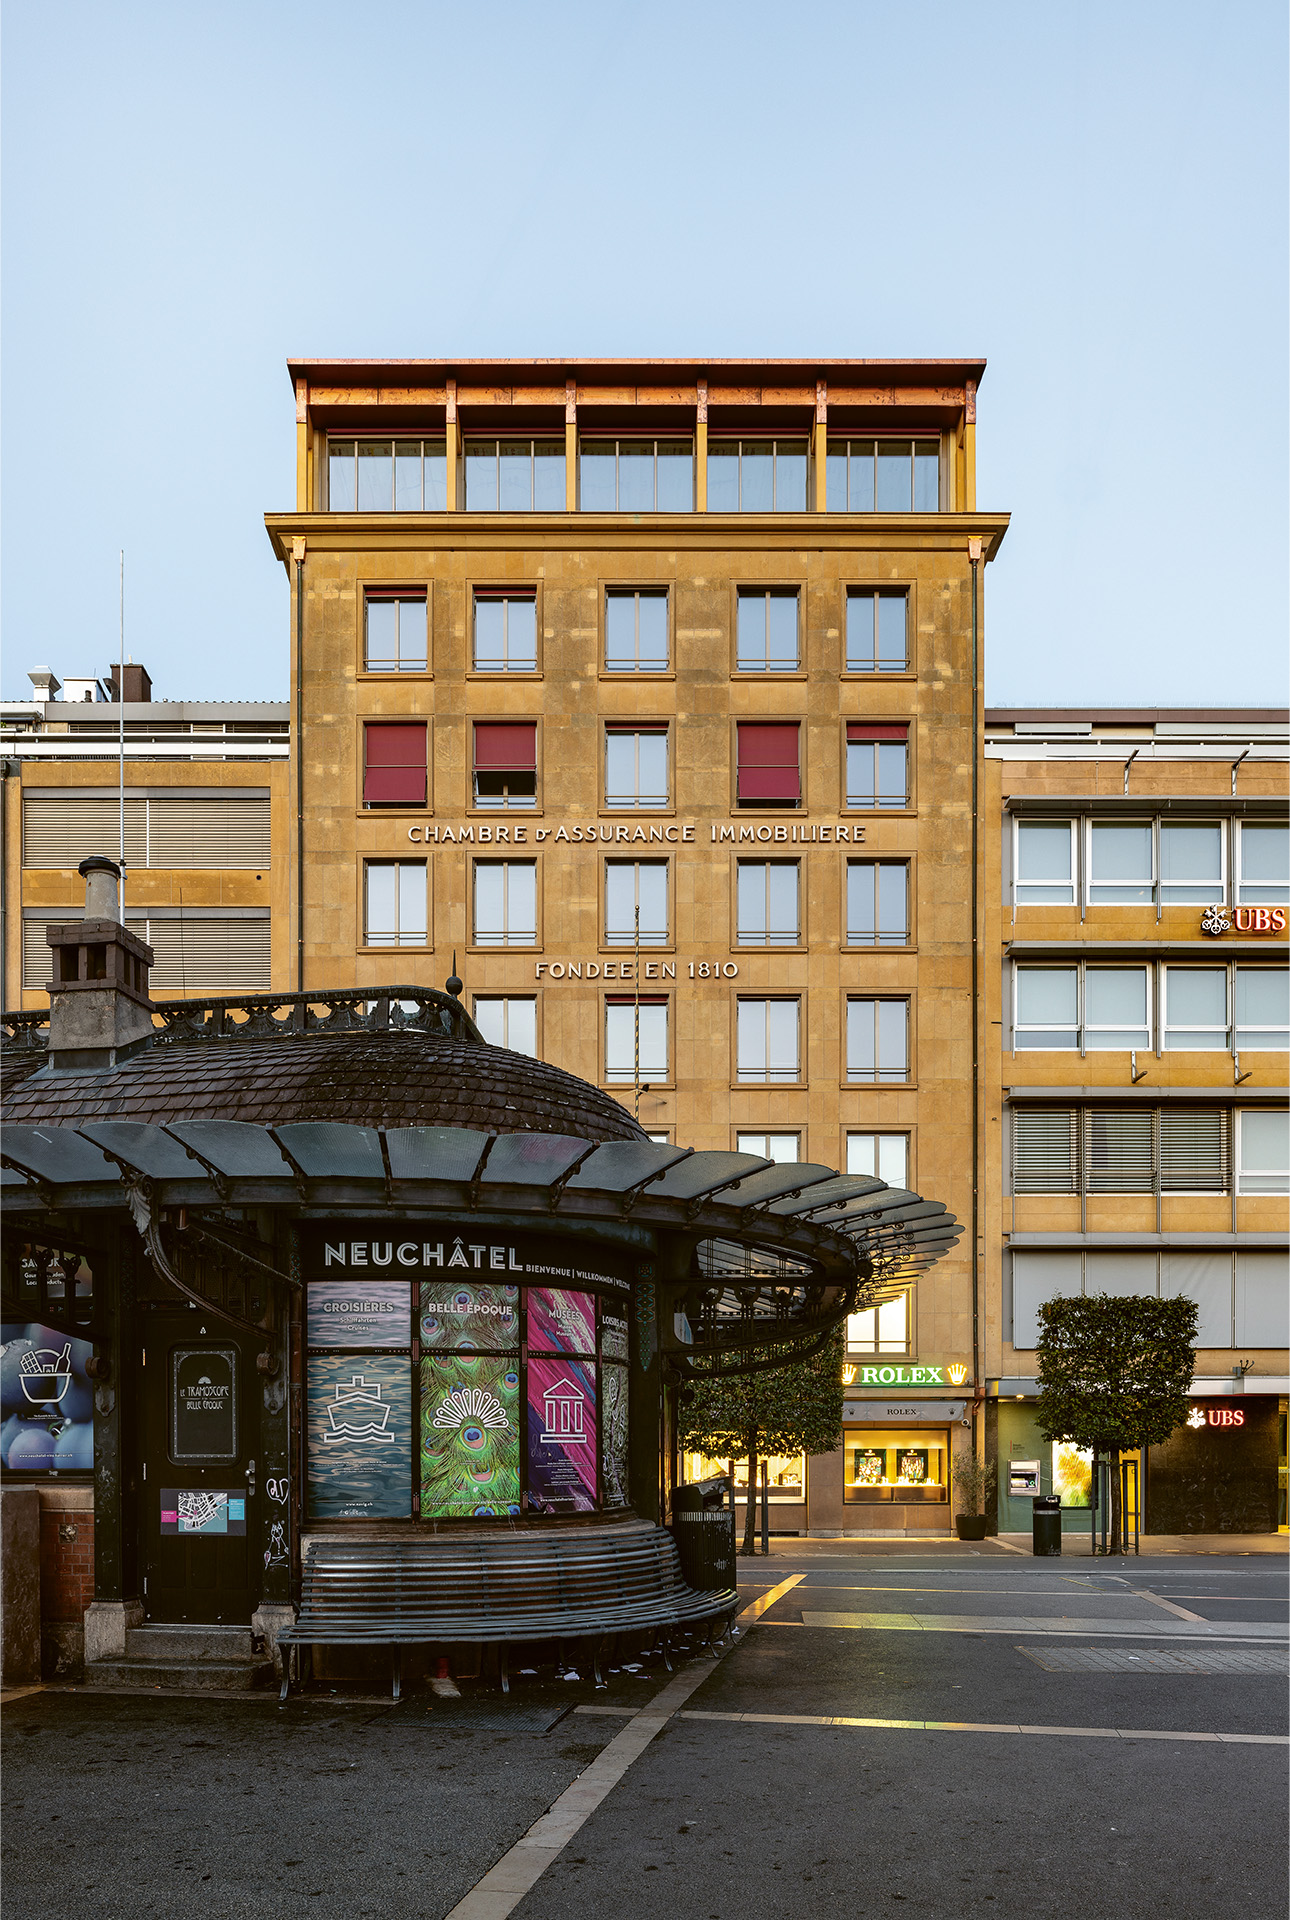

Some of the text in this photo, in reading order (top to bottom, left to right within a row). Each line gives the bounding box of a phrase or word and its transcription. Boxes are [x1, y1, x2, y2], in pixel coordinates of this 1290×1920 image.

[407, 825, 527, 843] CHAMBRE
[710, 825, 866, 843] IMMOBILIERE
[1234, 908, 1286, 931] UBS
[535, 962, 739, 979] FONDEE EN 1810
[324, 1236, 524, 1271] NEUCHÂTEL
[525, 1264, 571, 1277] BIENVENUE
[576, 1270, 614, 1285] WILLKOMMEN
[323, 1300, 394, 1313] CROISIÈRES
[428, 1301, 513, 1316] BELLE ÉPOQUE
[548, 1308, 580, 1321] MUSÉES
[861, 1366, 944, 1384] ROLEX
[187, 1386, 229, 1397] TRAMOSCOPE
[186, 1401, 201, 1410] BELLE
[886, 1408, 917, 1416] ROLEX
[1208, 1409, 1244, 1426] UBS
